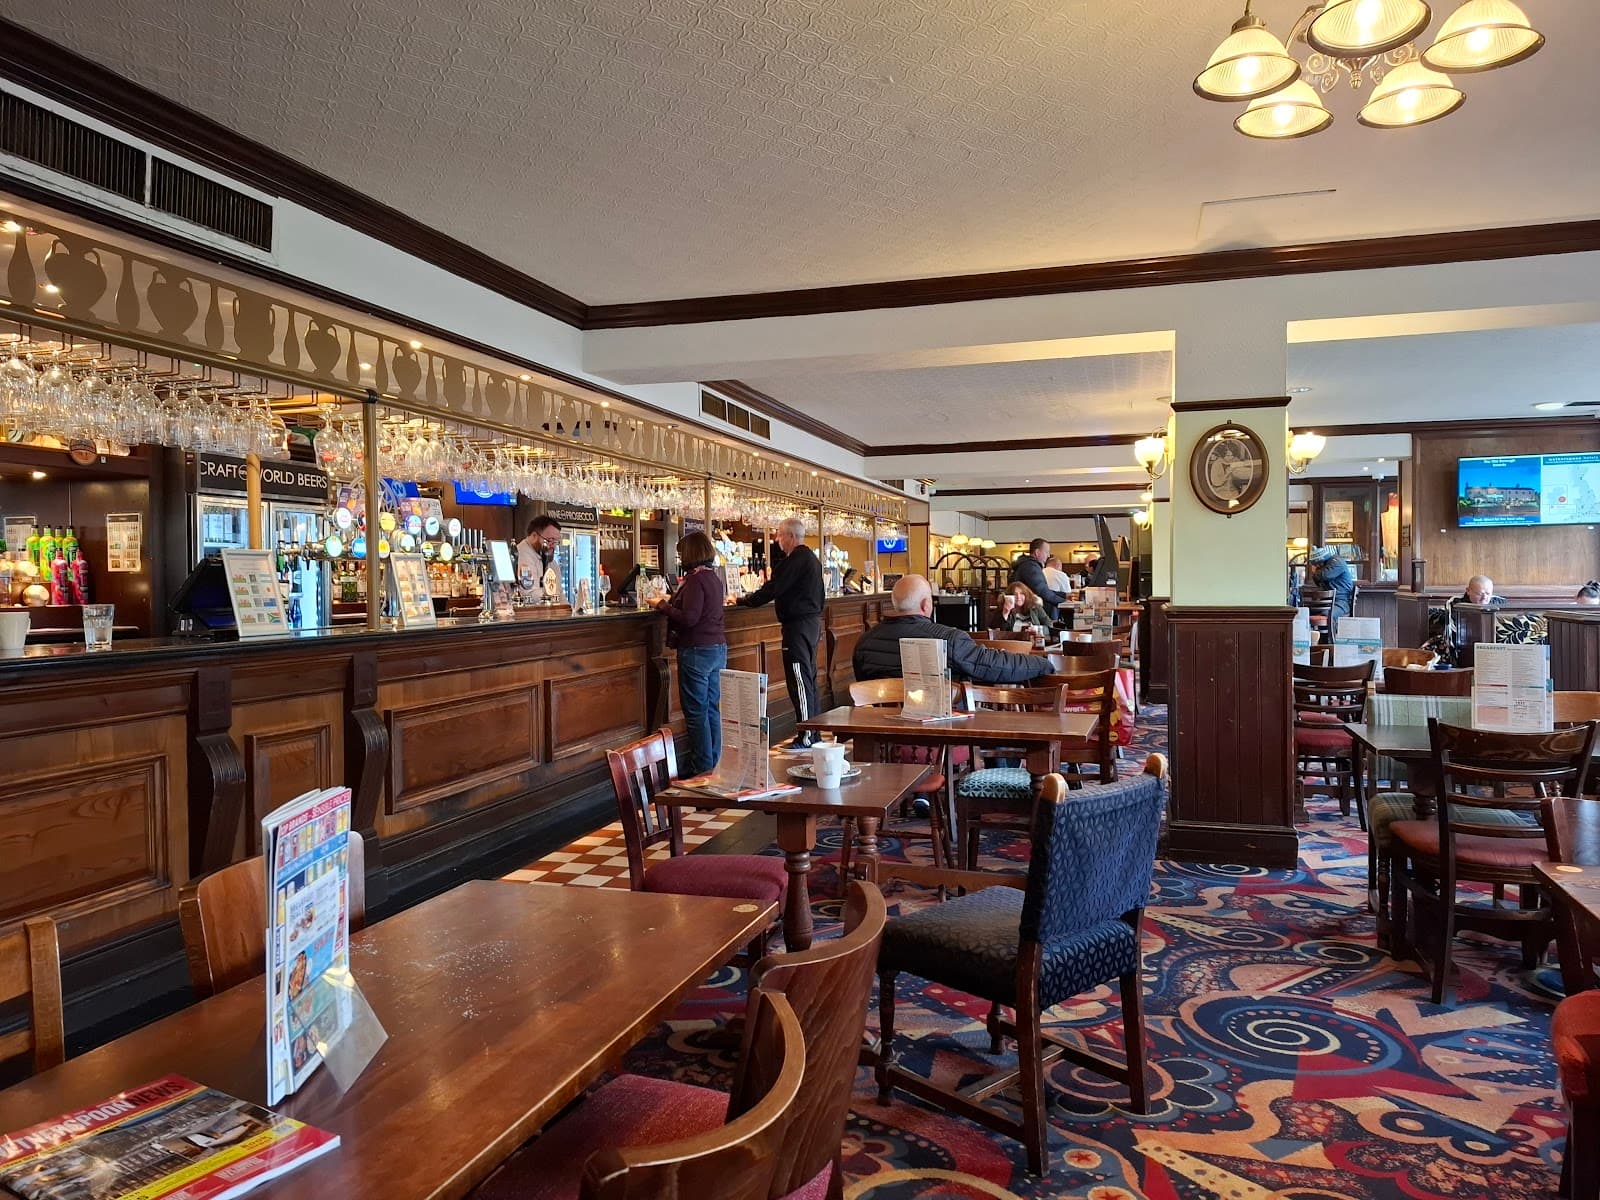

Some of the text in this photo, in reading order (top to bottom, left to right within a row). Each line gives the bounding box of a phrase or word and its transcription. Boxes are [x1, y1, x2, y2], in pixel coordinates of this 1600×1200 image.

[200, 461, 238, 479] CRAFT
[298, 474, 328, 489] BEERS
[127, 1082, 185, 1107] NEWS
